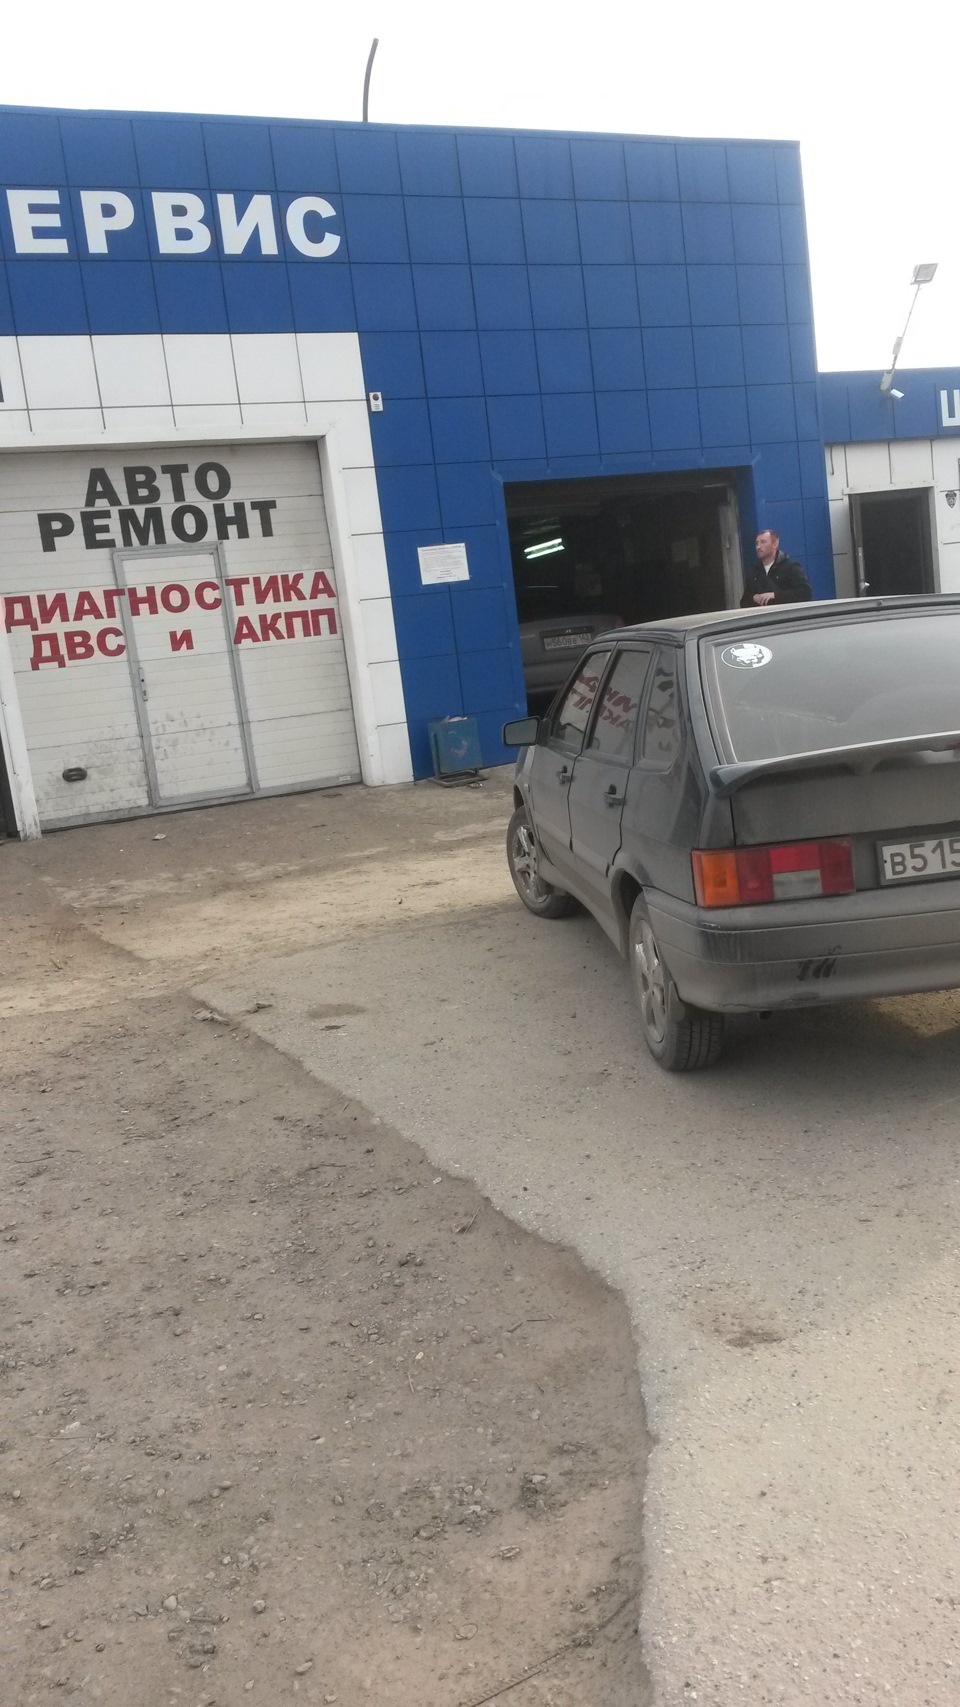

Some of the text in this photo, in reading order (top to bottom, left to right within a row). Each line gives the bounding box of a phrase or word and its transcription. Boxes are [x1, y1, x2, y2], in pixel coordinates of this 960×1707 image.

[6, 189, 341, 258] ЕРВИС
[84, 462, 231, 508] АВТО
[37, 500, 277, 552] РЕМОНТ
[4, 571, 337, 633] ДИАГНОСТИКА
[30, 627, 126, 671] ДВС
[234, 608, 338, 645] АКПП
